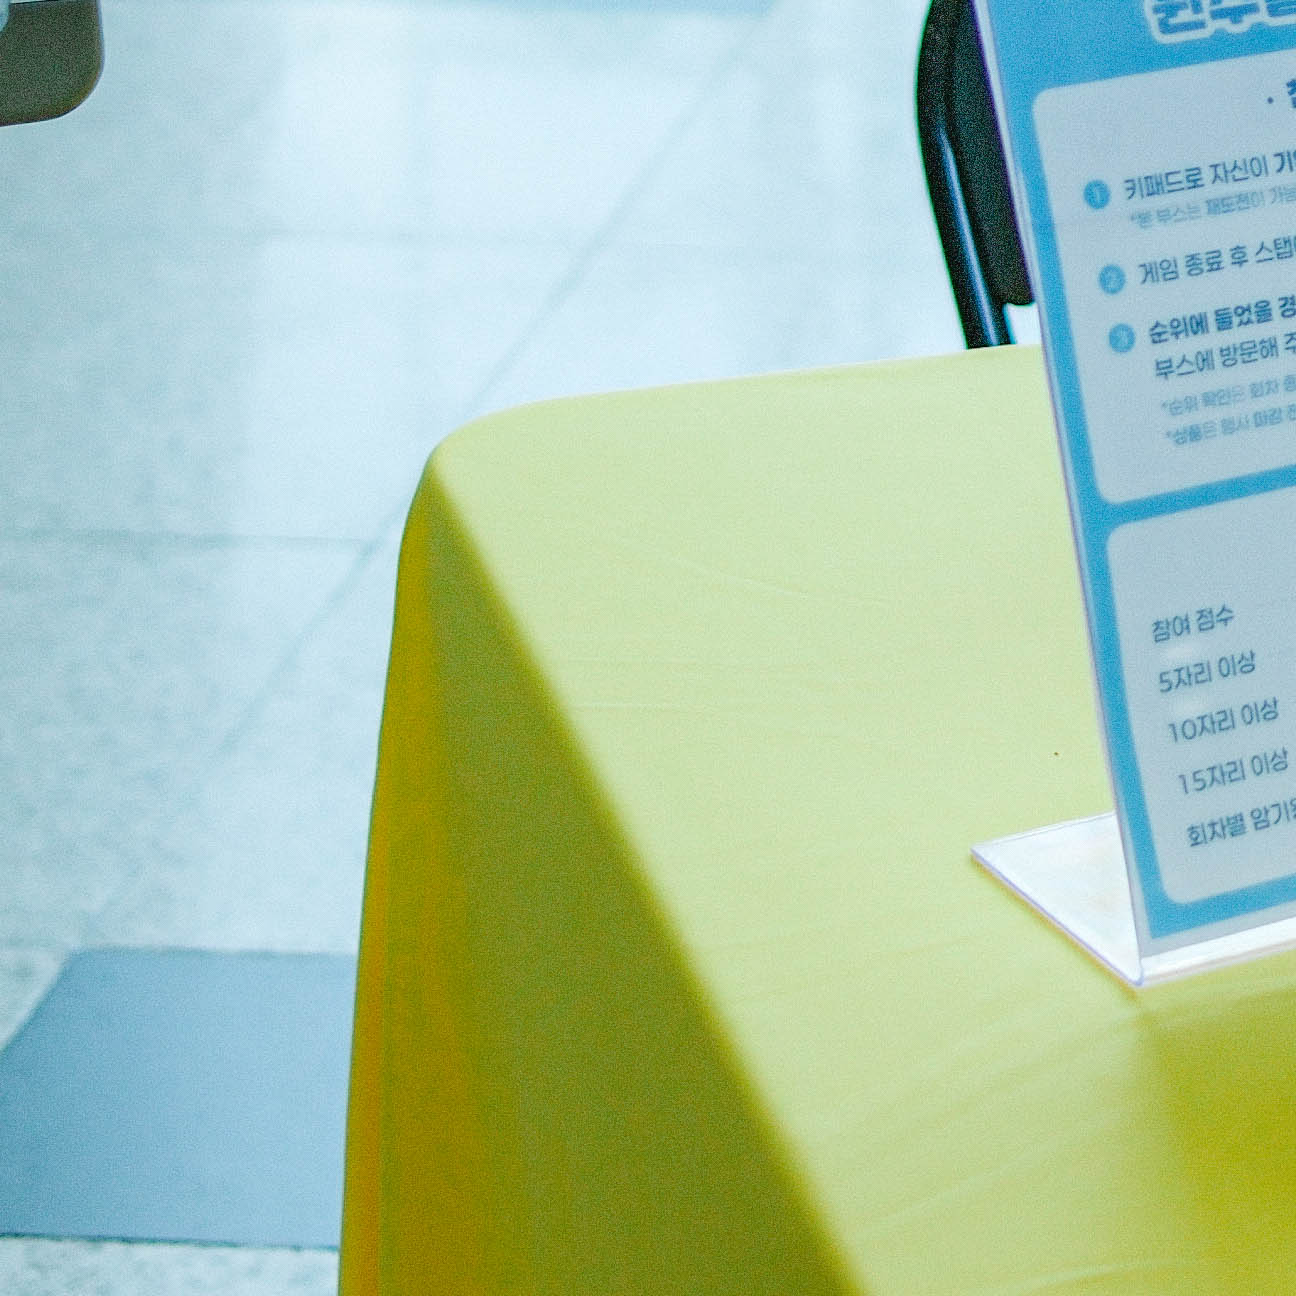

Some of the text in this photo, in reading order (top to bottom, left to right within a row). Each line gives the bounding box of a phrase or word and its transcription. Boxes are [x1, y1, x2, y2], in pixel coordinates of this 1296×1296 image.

[1124, 167, 1205, 201] 키패드로
[1209, 155, 1269, 185] 자신이
[1138, 257, 1180, 285] 게임
[1184, 249, 1225, 277] 종료
[1229, 245, 1249, 268] 후
[1149, 311, 1210, 345] 순위에
[1213, 299, 1274, 332] 들었을
[1154, 354, 1217, 381] 부스에
[1219, 336, 1280, 368] 방문해
[1151, 603, 1235, 644] 참여 점수
[1159, 649, 1256, 694] 5자리 이상
[1167, 695, 1280, 743] 10자리 이상
[1178, 746, 1290, 795] 15자리 이상
[1186, 811, 1249, 848] 회차별
